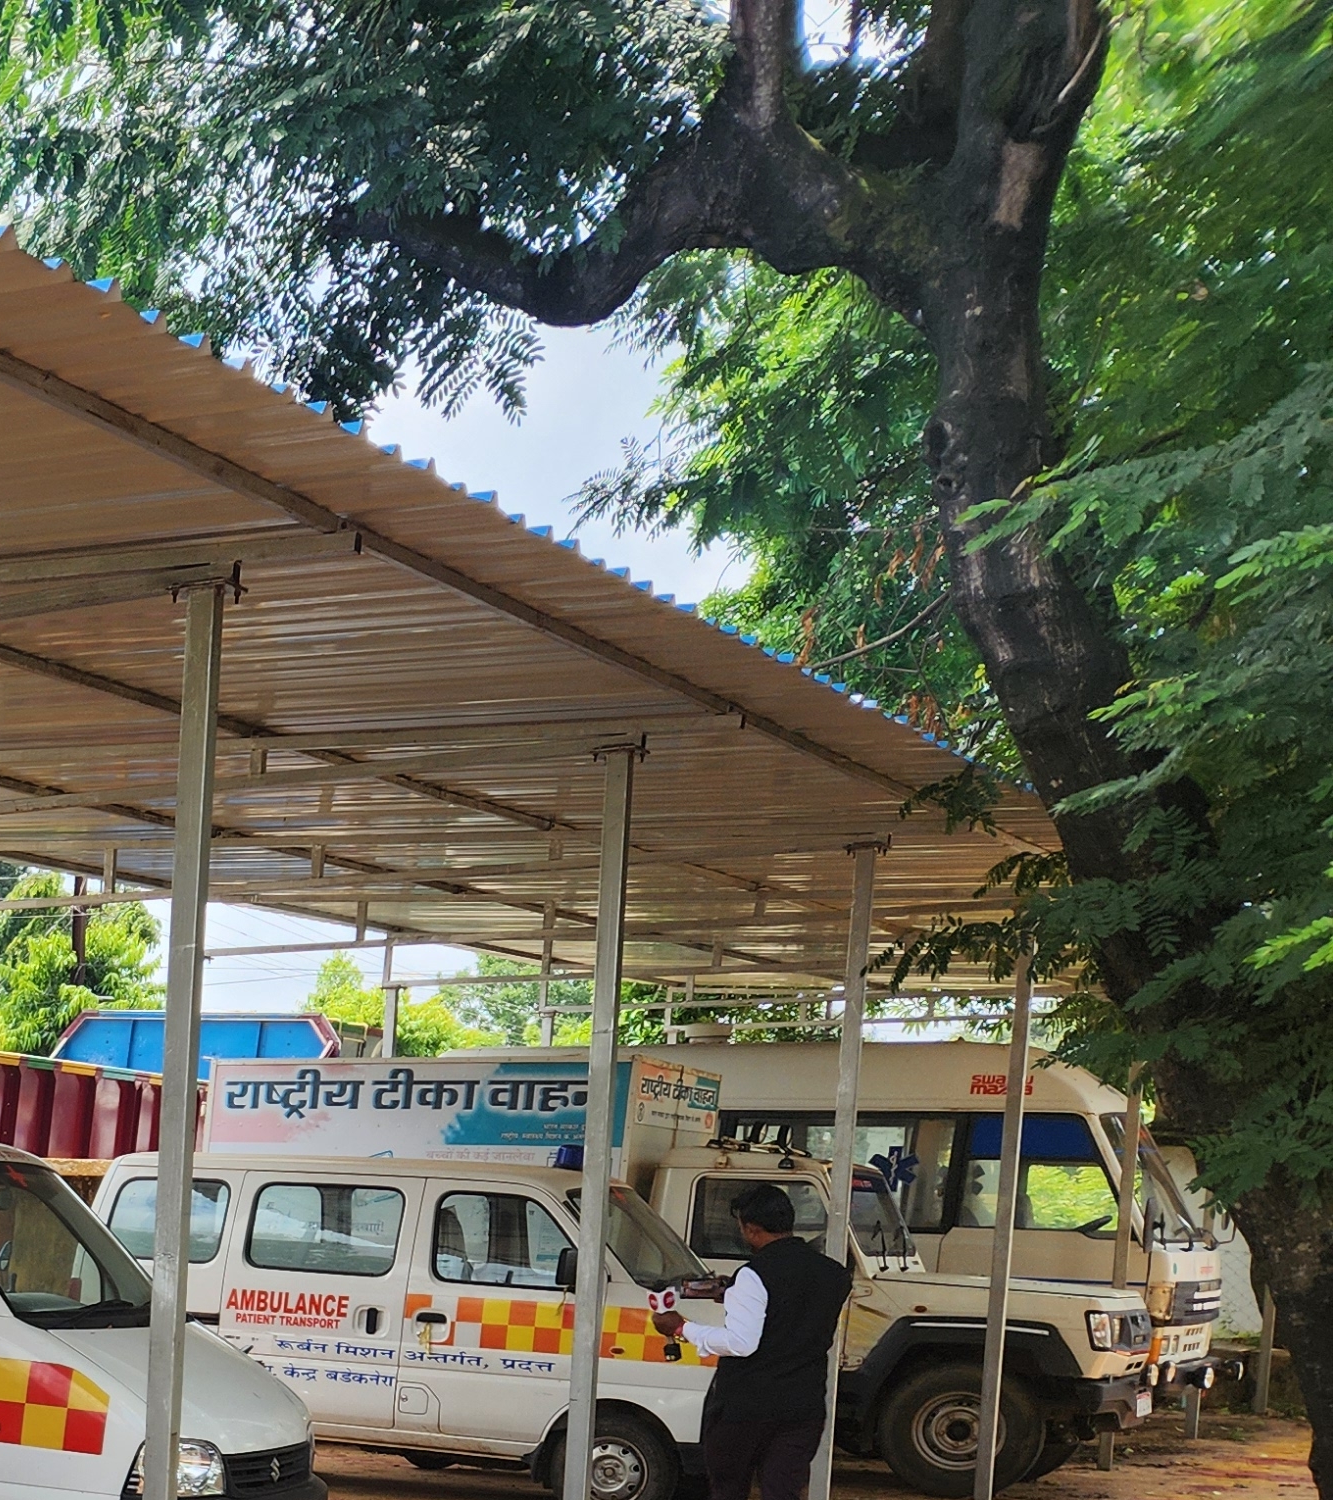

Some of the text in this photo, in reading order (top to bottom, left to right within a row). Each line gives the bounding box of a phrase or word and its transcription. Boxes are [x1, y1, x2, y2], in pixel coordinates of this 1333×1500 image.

[971, 1074, 1034, 1085] swaj
[225, 1068, 365, 1119] राष्ट्रीय
[371, 1067, 480, 1111] टीका
[640, 1073, 717, 1106] राष्ट्रीय टीका वाहन
[969, 1084, 1033, 1096] maza
[455, 1148, 471, 1160] की
[226, 1288, 350, 1318] AMBULANCE
[235, 1312, 341, 1330] PATIENT TRANSPORT
[335, 1342, 396, 1360] मिशन
[499, 1357, 556, 1373] प्रदत्त
[282, 1362, 319, 1381] केन्द्र
